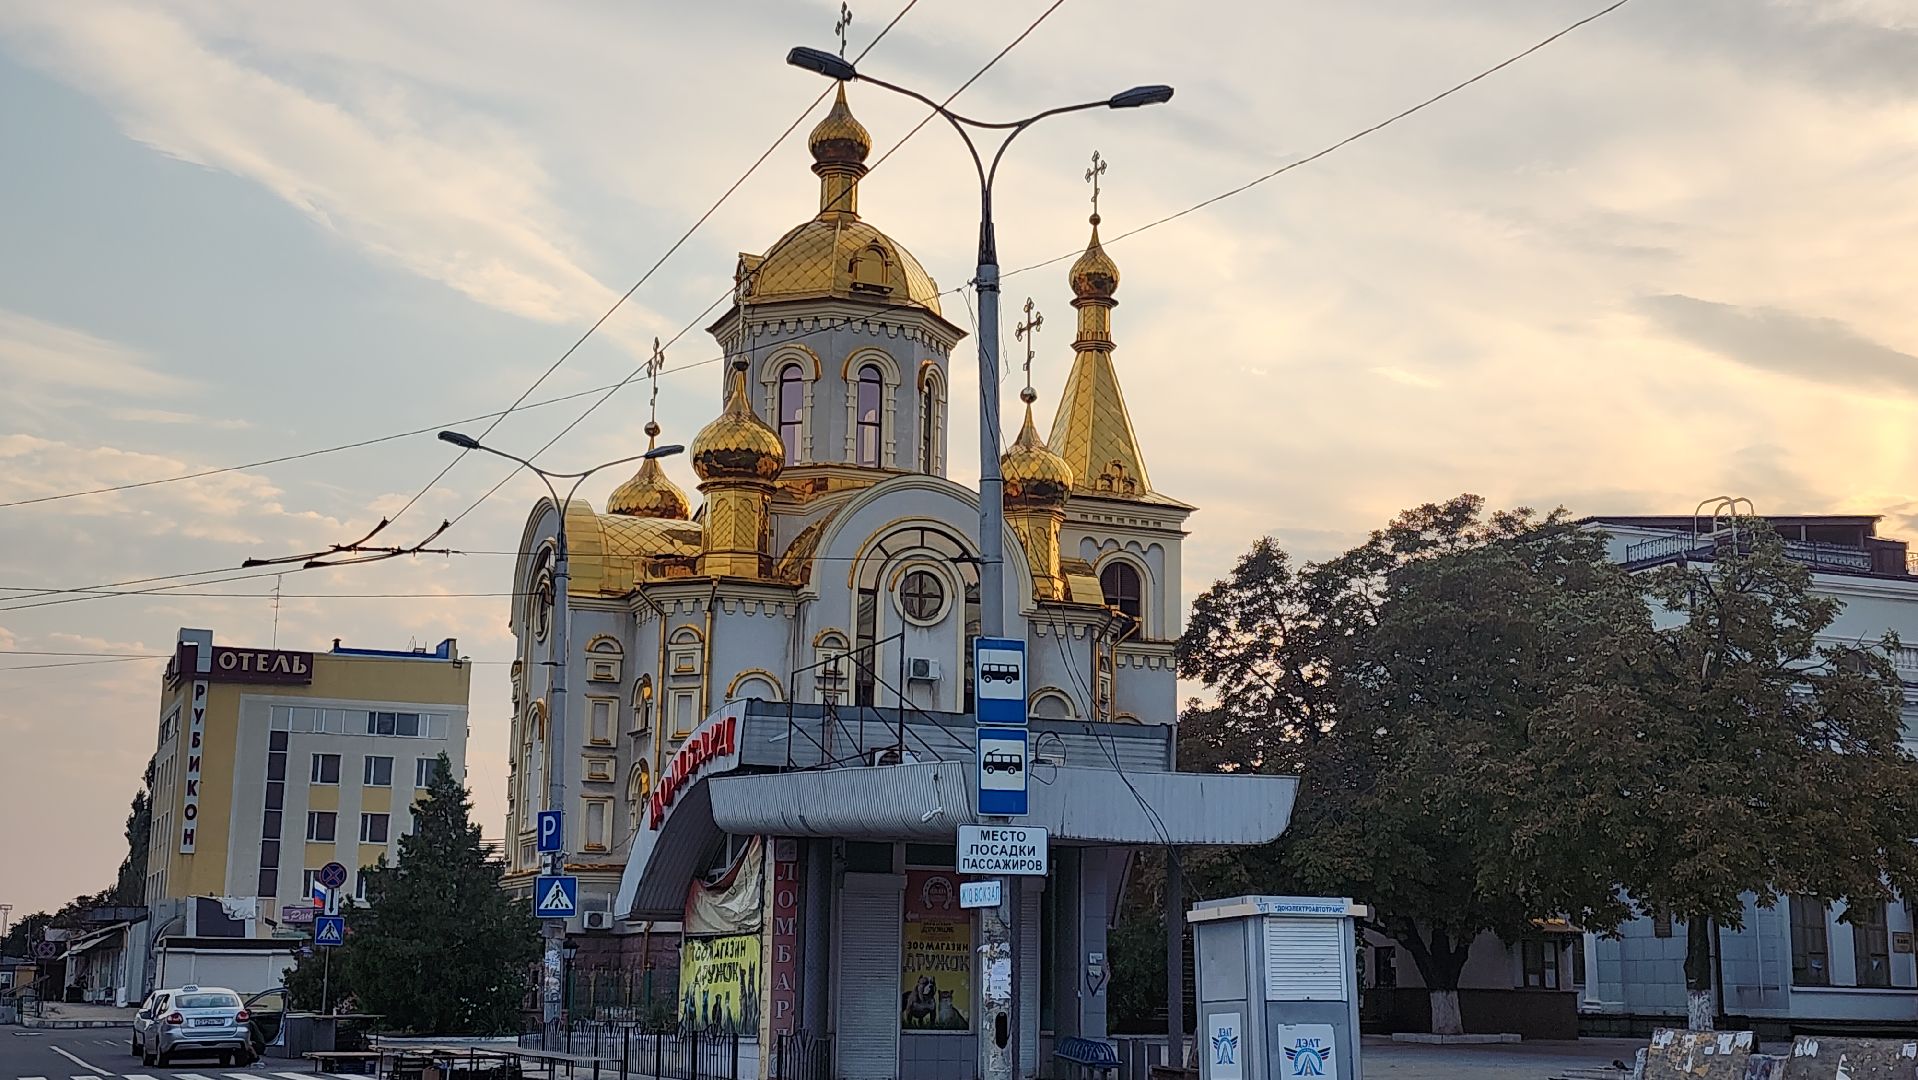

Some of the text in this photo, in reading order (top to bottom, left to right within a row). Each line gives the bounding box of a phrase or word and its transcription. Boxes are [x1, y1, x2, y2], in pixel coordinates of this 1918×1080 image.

[218, 651, 307, 674] ОТЕЛЬ
[183, 684, 205, 845] РУБИКОН
[649, 716, 737, 831] ЛОМБАРД
[542, 815, 556, 847] P
[980, 830, 1026, 842] МЕСТО
[970, 844, 1036, 857] ПОСАДКИ
[962, 858, 1042, 871] ПАССАЖИРОВ
[907, 941, 969, 951] ЗООМАГАЗИН
[904, 952, 970, 973] ДРУЖОК
[1217, 1027, 1233, 1038] ДЭАТ
[1295, 1038, 1321, 1049] ДЭАТ
